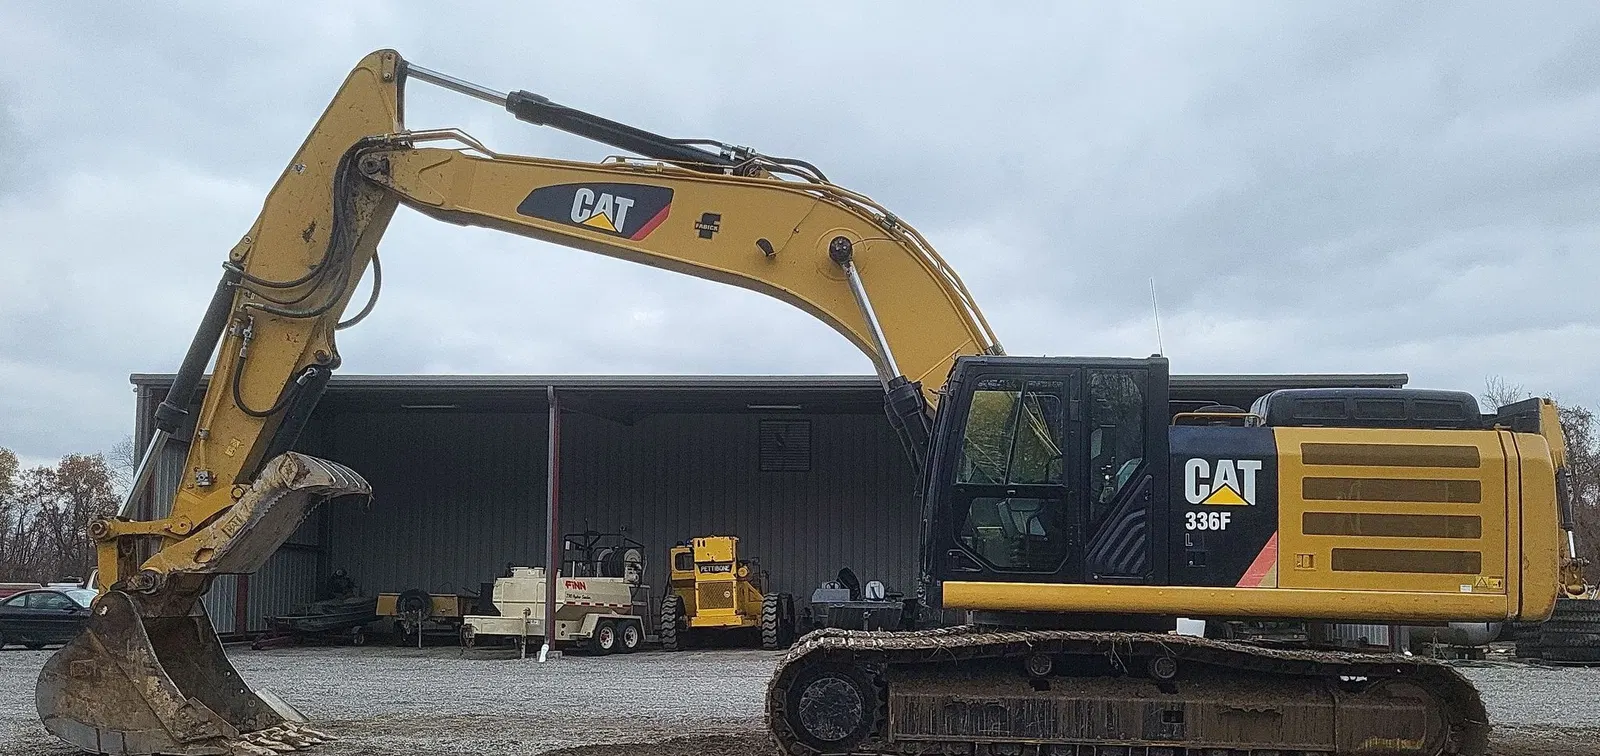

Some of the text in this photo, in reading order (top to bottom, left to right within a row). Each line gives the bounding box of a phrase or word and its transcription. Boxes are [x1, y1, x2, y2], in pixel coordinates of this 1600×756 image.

[570, 187, 635, 234] CAT
[1185, 457, 1262, 506] CAT
[1185, 511, 1231, 531] 336F
[1185, 533, 1194, 546] L
